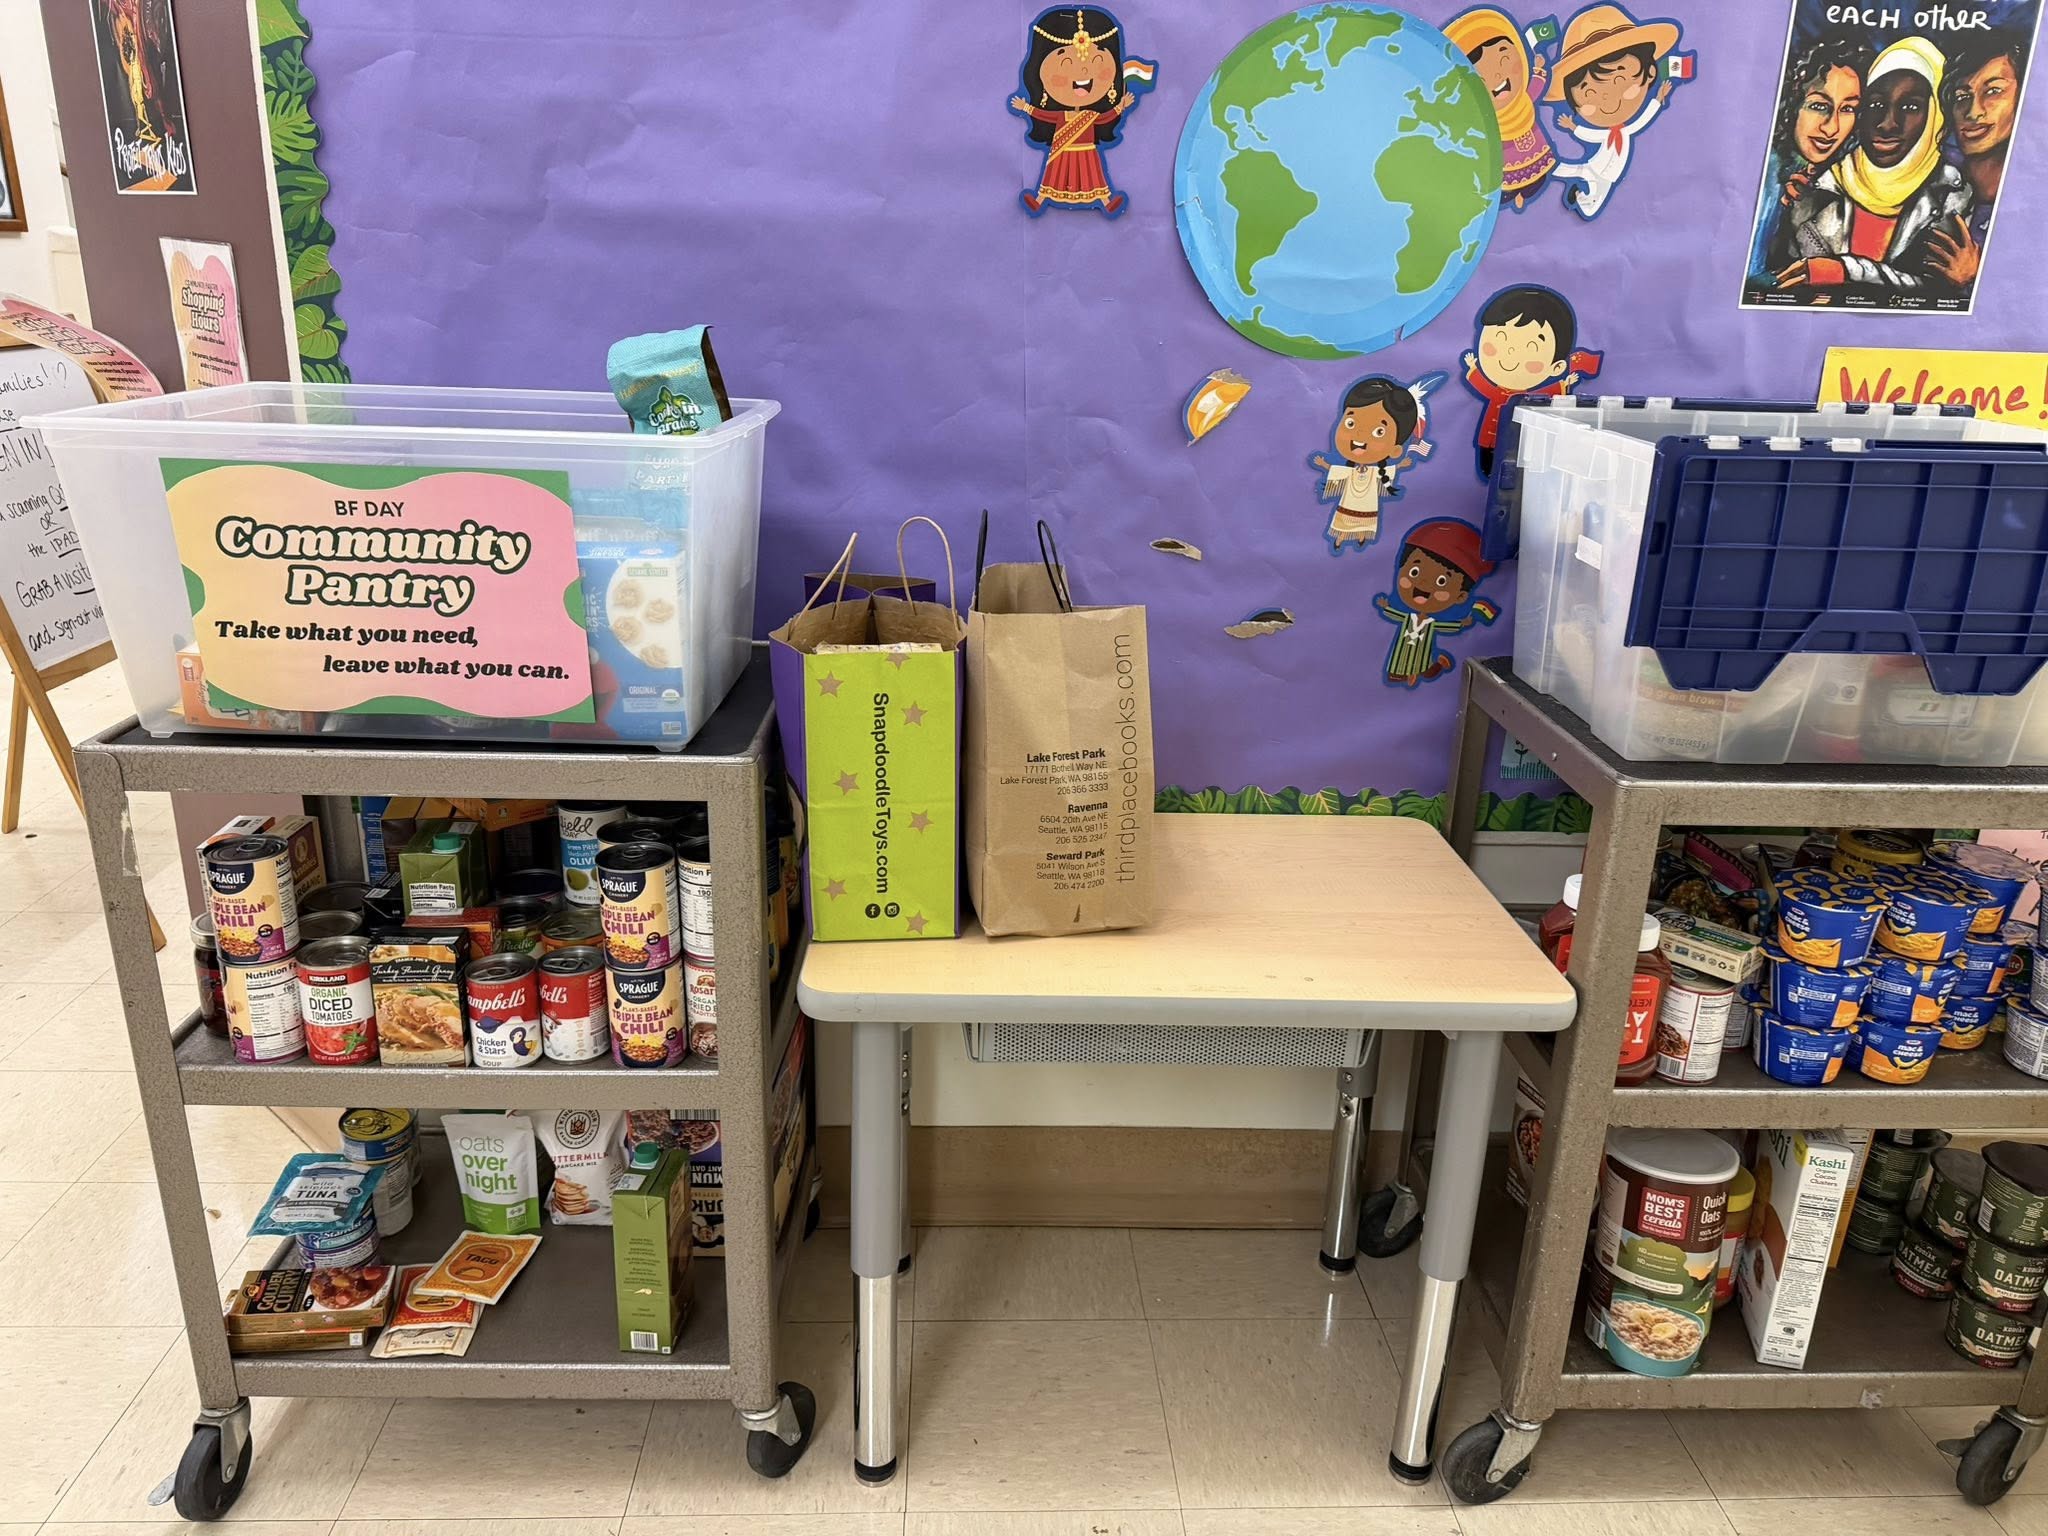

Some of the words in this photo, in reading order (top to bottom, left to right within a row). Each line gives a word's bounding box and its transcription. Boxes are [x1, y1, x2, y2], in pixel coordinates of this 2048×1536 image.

[182, 286, 225, 318] Shopping
[191, 309, 220, 334] Hours
[0, 362, 51, 395] milies!
[334, 500, 360, 518] BF
[364, 501, 405, 519] DAY
[27, 543, 48, 558] the
[216, 515, 532, 575] Community
[286, 564, 476, 617] Pantry
[28, 624, 56, 652] and
[214, 620, 280, 640] Take
[285, 622, 353, 642] what
[357, 627, 408, 646] you
[412, 626, 479, 648] need,
[323, 655, 389, 673] leave
[394, 657, 461, 675] what
[465, 661, 513, 680] you
[518, 662, 570, 680] can.
[628, 686, 657, 695] ORIGINAL
[1027, 752, 1051, 763] Lake
[1052, 751, 1080, 761] Forest
[1082, 748, 1106, 759] Park
[1114, 633, 1140, 883] thirdplacebooks.com
[1024, 765, 1049, 774] 17171
[1076, 762, 1094, 772] Way
[1095, 761, 1108, 770] NE
[1000, 776, 1020, 785] Lake
[1021, 776, 1048, 785] Forest
[1068, 774, 1082, 783] WA
[1082, 772, 1109, 782] 98155
[870, 692, 891, 894] SnapdoodleToys.com
[1057, 786, 1071, 795] 206
[1088, 783, 1109, 793] 3333
[1068, 801, 1109, 814] Ravenna
[1040, 815, 1060, 824] 6504
[1062, 815, 1081, 824] 20th
[1082, 814, 1097, 823] Ave
[1097, 812, 1109, 820] NE
[1069, 825, 1084, 833] WA
[1084, 823, 1109, 832] 98115
[1056, 836, 1071, 845] 206
[1072, 834, 1088, 844] 525
[1089, 832, 1108, 843] 2347
[569, 857, 596, 866] OLIV
[1046, 851, 1083, 861] Seward
[1084, 848, 1105, 859] Park
[1036, 862, 1056, 870] 5041
[1057, 861, 1085, 870] Wilson
[1086, 860, 1100, 869] Ave
[1099, 858, 1106, 866] S
[1067, 872, 1082, 880] WA
[1082, 869, 1105, 879] 98118
[601, 878, 638, 893] SPRAGUE
[1053, 882, 1070, 890] 206
[1070, 881, 1086, 890] 474
[1087, 879, 1105, 889] 2200
[233, 901, 266, 914] BEAN
[624, 910, 656, 922] BEAN
[604, 920, 644, 935] CHILI
[245, 966, 287, 980] Nutrition
[308, 975, 346, 983] KIRKLAND
[372, 965, 399, 981] Turkey
[310, 987, 347, 998] ORGANIC
[619, 981, 659, 994] SPRAGUE
[690, 984, 715, 996] Rosar
[309, 997, 353, 1011] DICED
[467, 987, 526, 1013] ampbell's
[311, 1010, 353, 1021] TOMATOES
[612, 1008, 643, 1023] TRIPLE
[645, 1007, 673, 1022] BEAN
[620, 1021, 664, 1035] CHILI
[475, 1036, 507, 1046] Chicken
[484, 1047, 506, 1055] Stars
[459, 1136, 505, 1153] oats
[462, 1154, 508, 1172] over
[1808, 1155, 1848, 1170] Kashi
[465, 1171, 518, 1194] night
[692, 1173, 723, 1184] MUN
[1809, 1178, 1838, 1187] Clusters
[1814, 1173, 1837, 1181] Cocoa
[295, 1190, 338, 1198] TUNA
[1646, 1191, 1685, 1208] MOM'S
[1703, 1191, 1727, 1210] Quick
[1644, 1201, 1684, 1219] BEST
[1700, 1210, 1721, 1225] Oats
[1643, 1214, 1682, 1229] cereals
[465, 1253, 500, 1265] TACO
[1994, 1268, 2044, 1287] OATME
[257, 1270, 286, 1311] GOLDEN
[273, 1270, 300, 1312] CURRY
[1975, 1327, 2024, 1347] OATME
